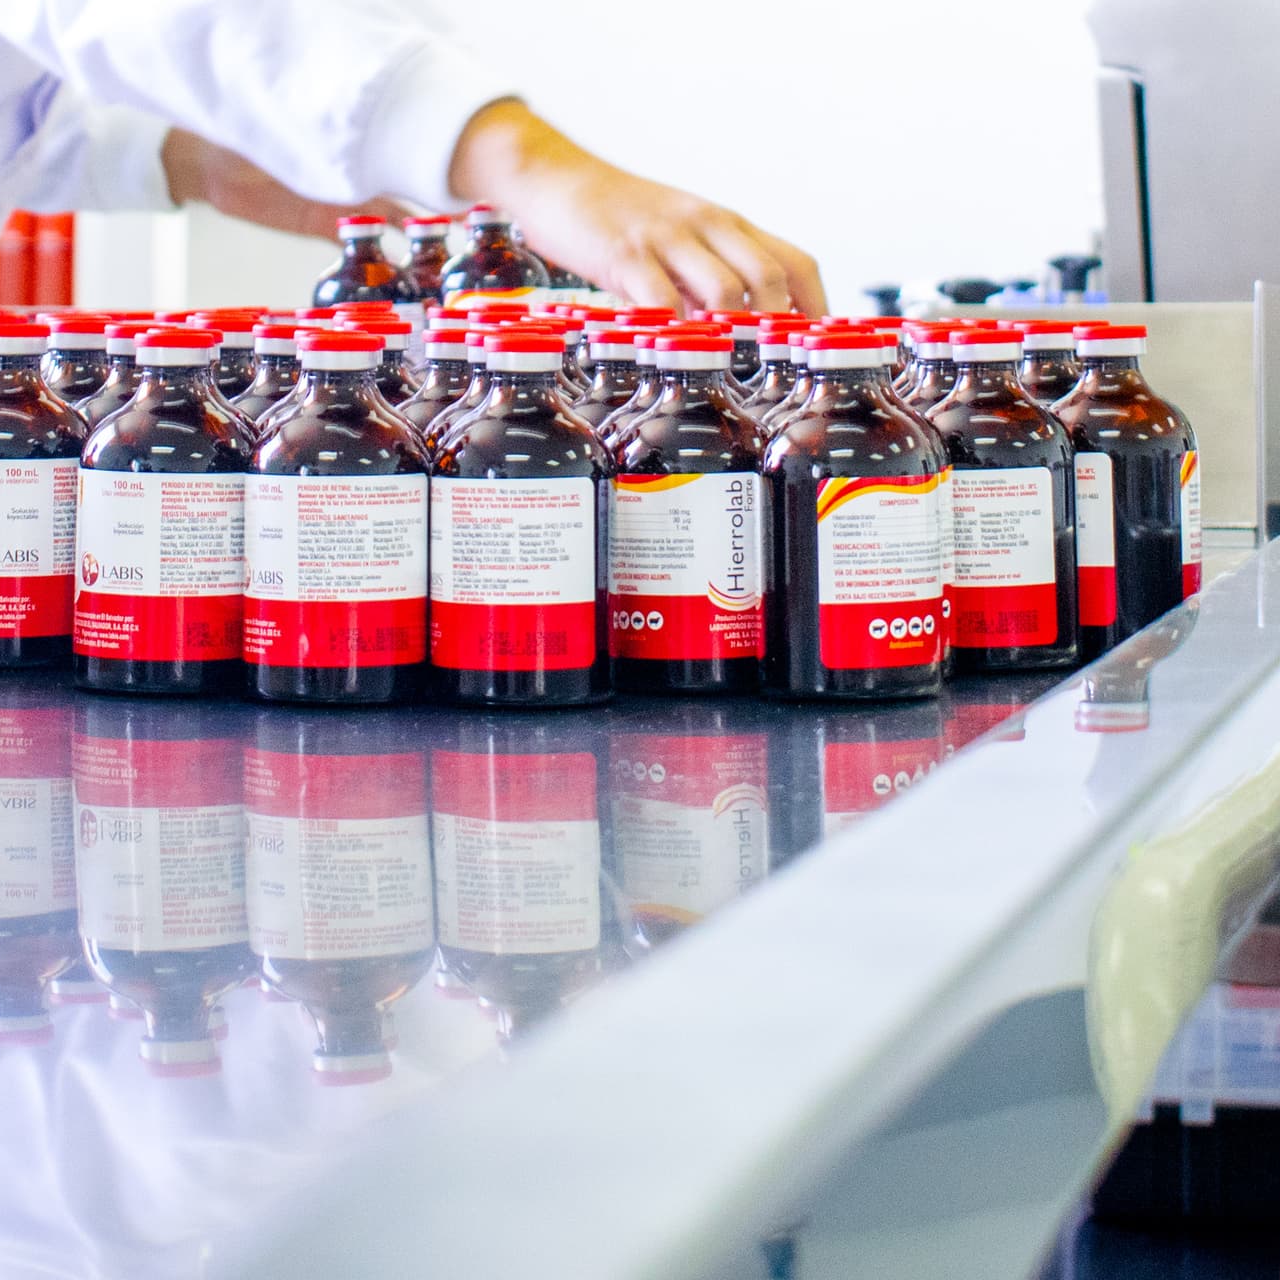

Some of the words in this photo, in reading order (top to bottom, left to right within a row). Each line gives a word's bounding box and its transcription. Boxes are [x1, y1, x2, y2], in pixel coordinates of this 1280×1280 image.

[6, 468, 22, 477] 100
[25, 468, 38, 477] mL
[113, 481, 127, 489] 100
[130, 481, 144, 489] mL
[270, 484, 283, 493] mL
[725, 480, 744, 592] Hierrolab
[102, 566, 143, 580] LABIS
[252, 570, 284, 584] LABIS
